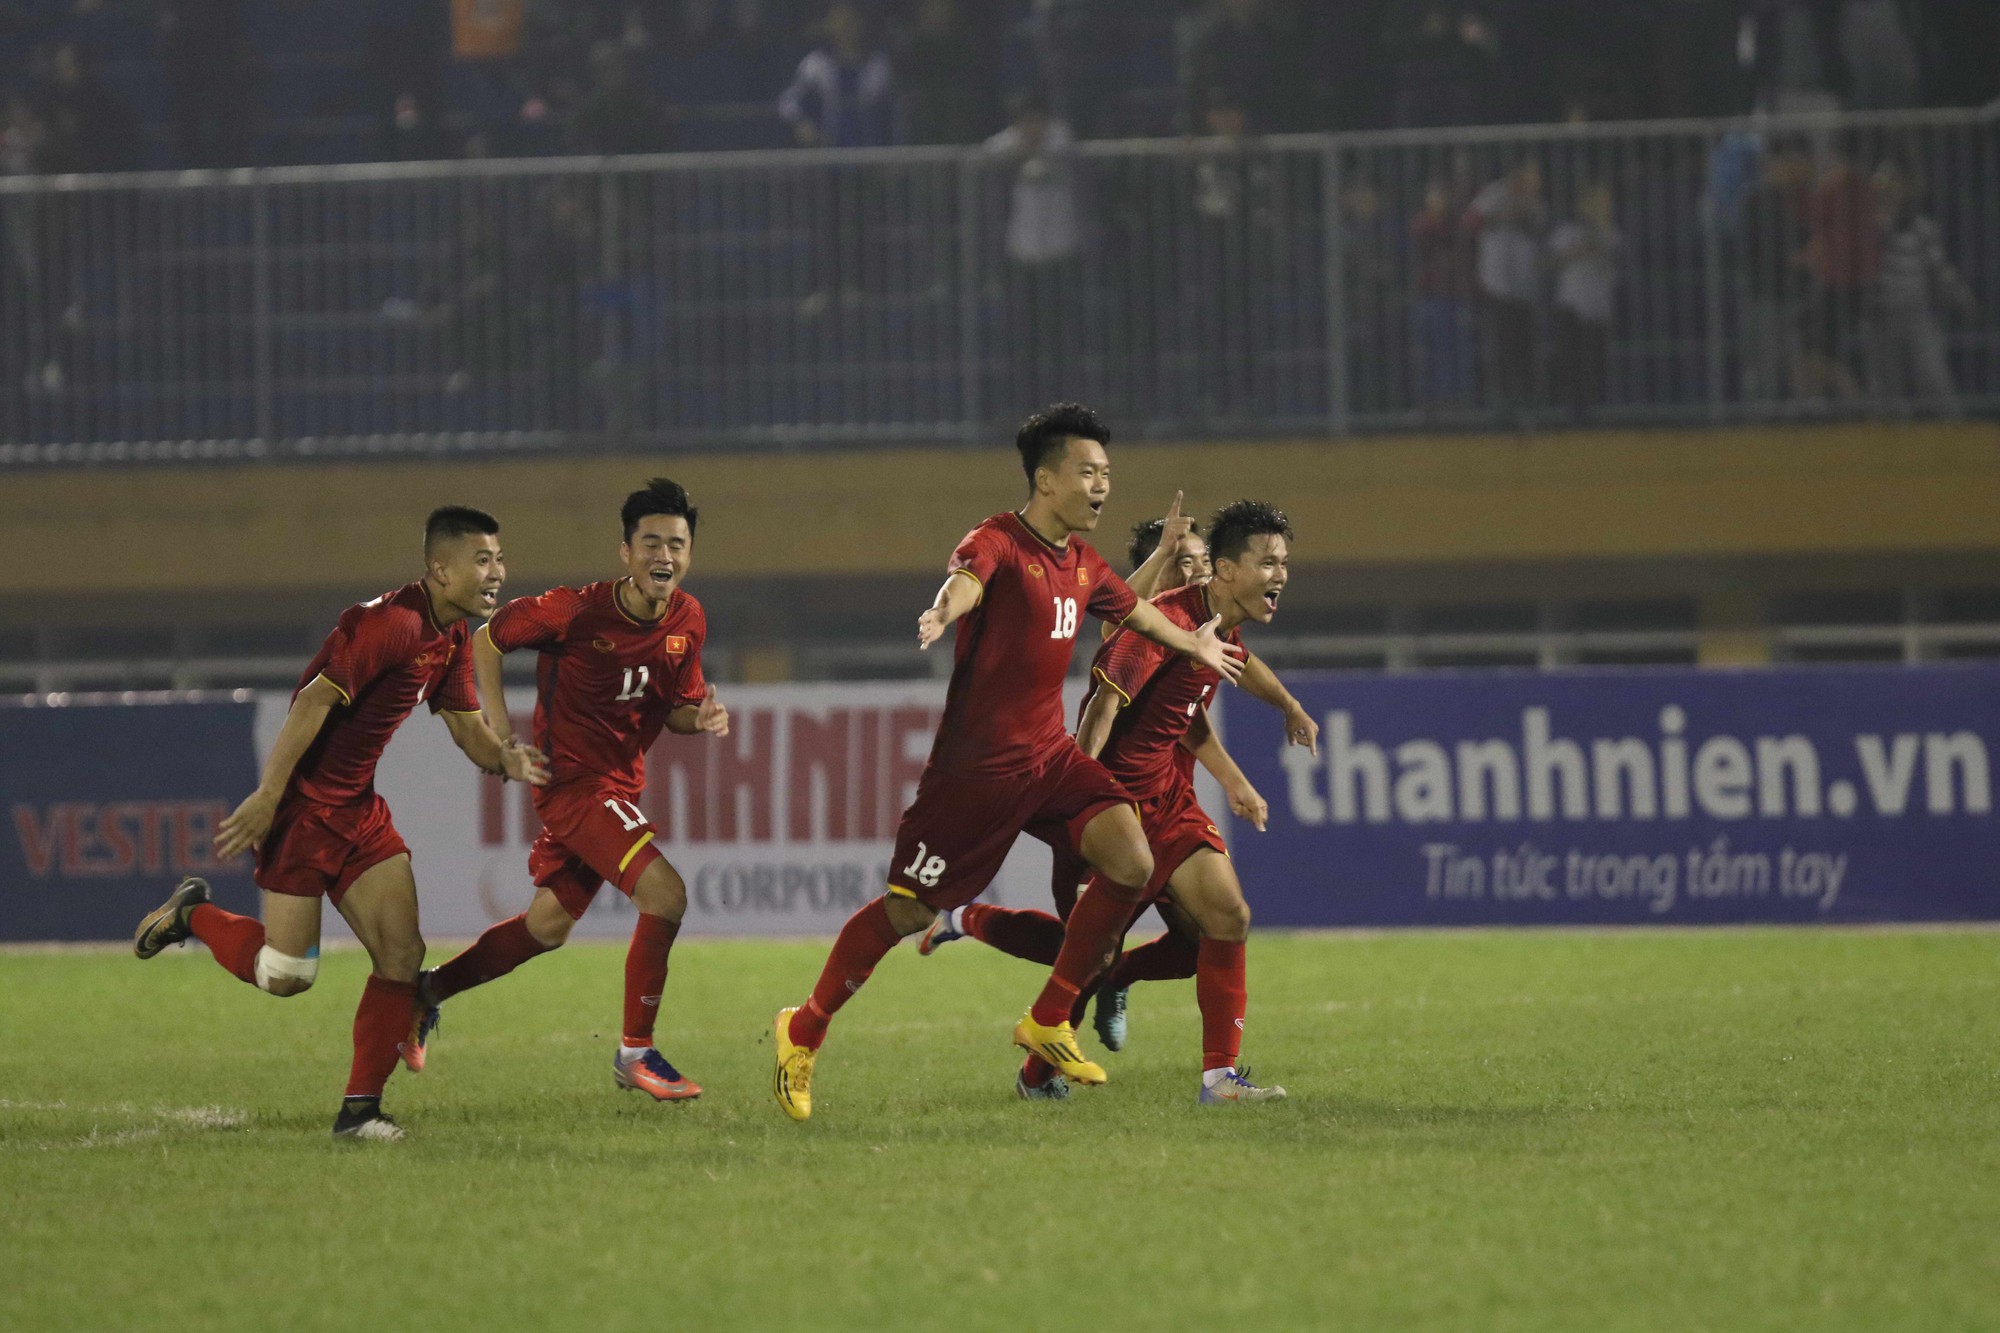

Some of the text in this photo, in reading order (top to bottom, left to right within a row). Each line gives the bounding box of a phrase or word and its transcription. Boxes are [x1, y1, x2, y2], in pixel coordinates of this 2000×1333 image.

[1051, 596, 1077, 639] 18
[615, 665, 649, 700] 11
[1281, 706, 1991, 823] thanhnien.vn
[604, 798, 648, 831] 11
[904, 841, 946, 887] 18
[1421, 843, 1486, 898] Tin
[1566, 847, 1677, 913] trong
[1779, 846, 1847, 911] tay
